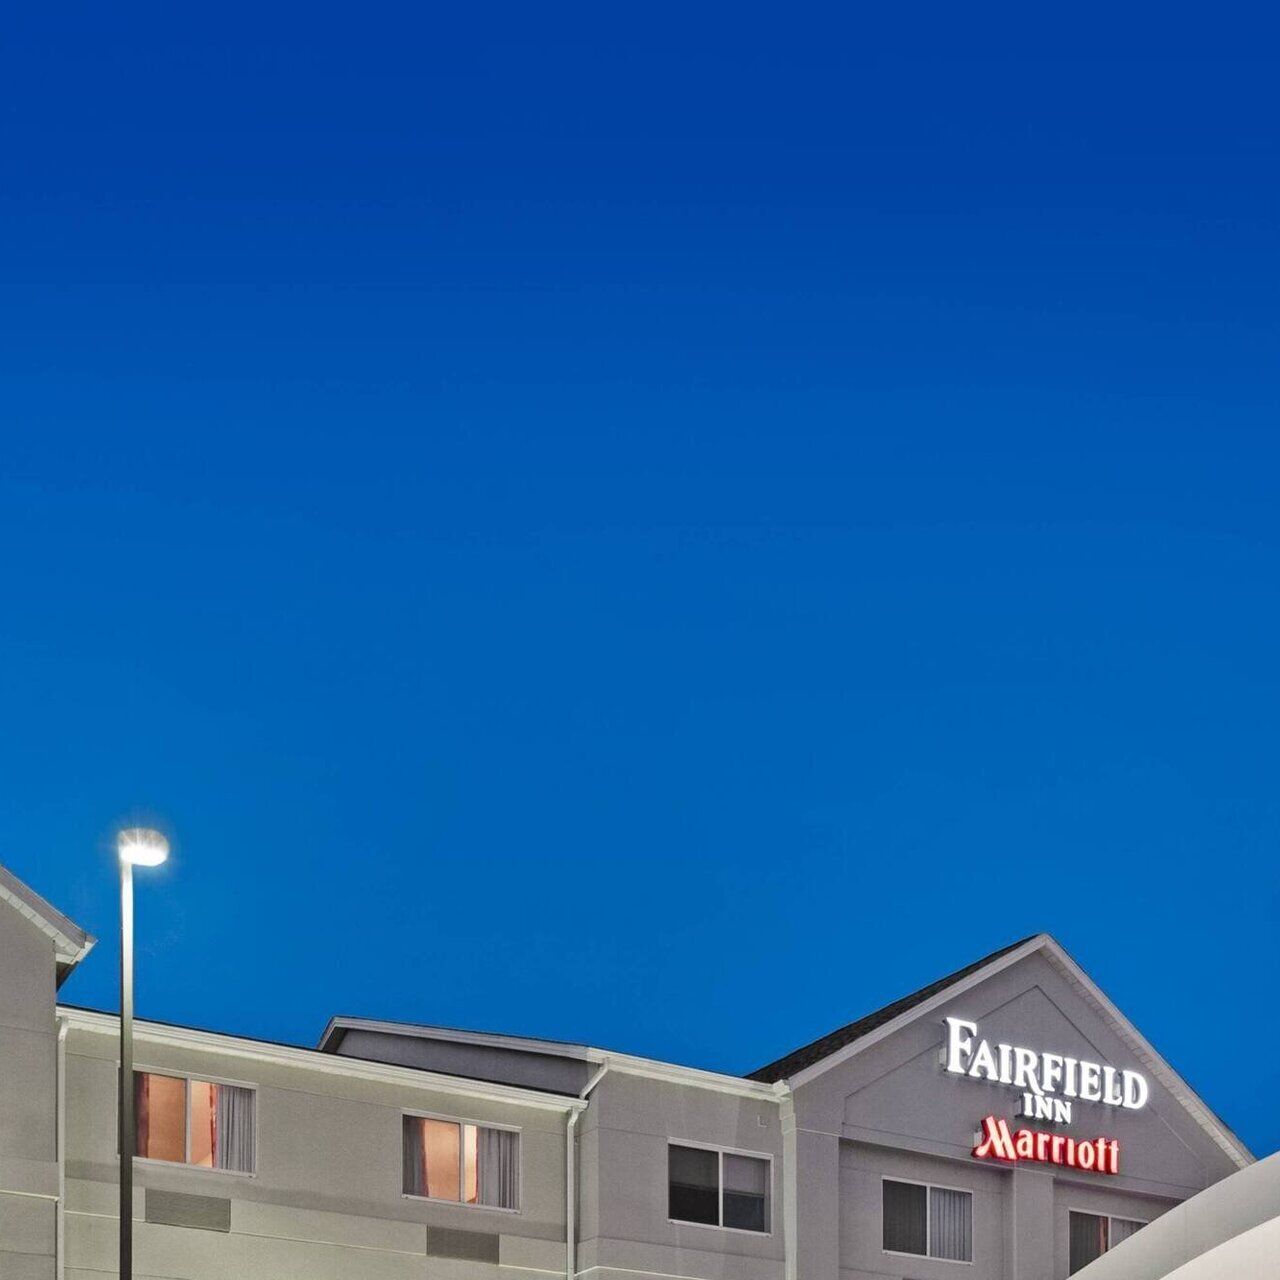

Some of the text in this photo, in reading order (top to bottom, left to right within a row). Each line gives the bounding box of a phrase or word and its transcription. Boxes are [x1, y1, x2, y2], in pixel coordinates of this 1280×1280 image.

[946, 1016, 1148, 1110] FAIRFIELD
[1023, 1092, 1071, 1124] INN
[972, 1115, 1119, 1174] Marriott
